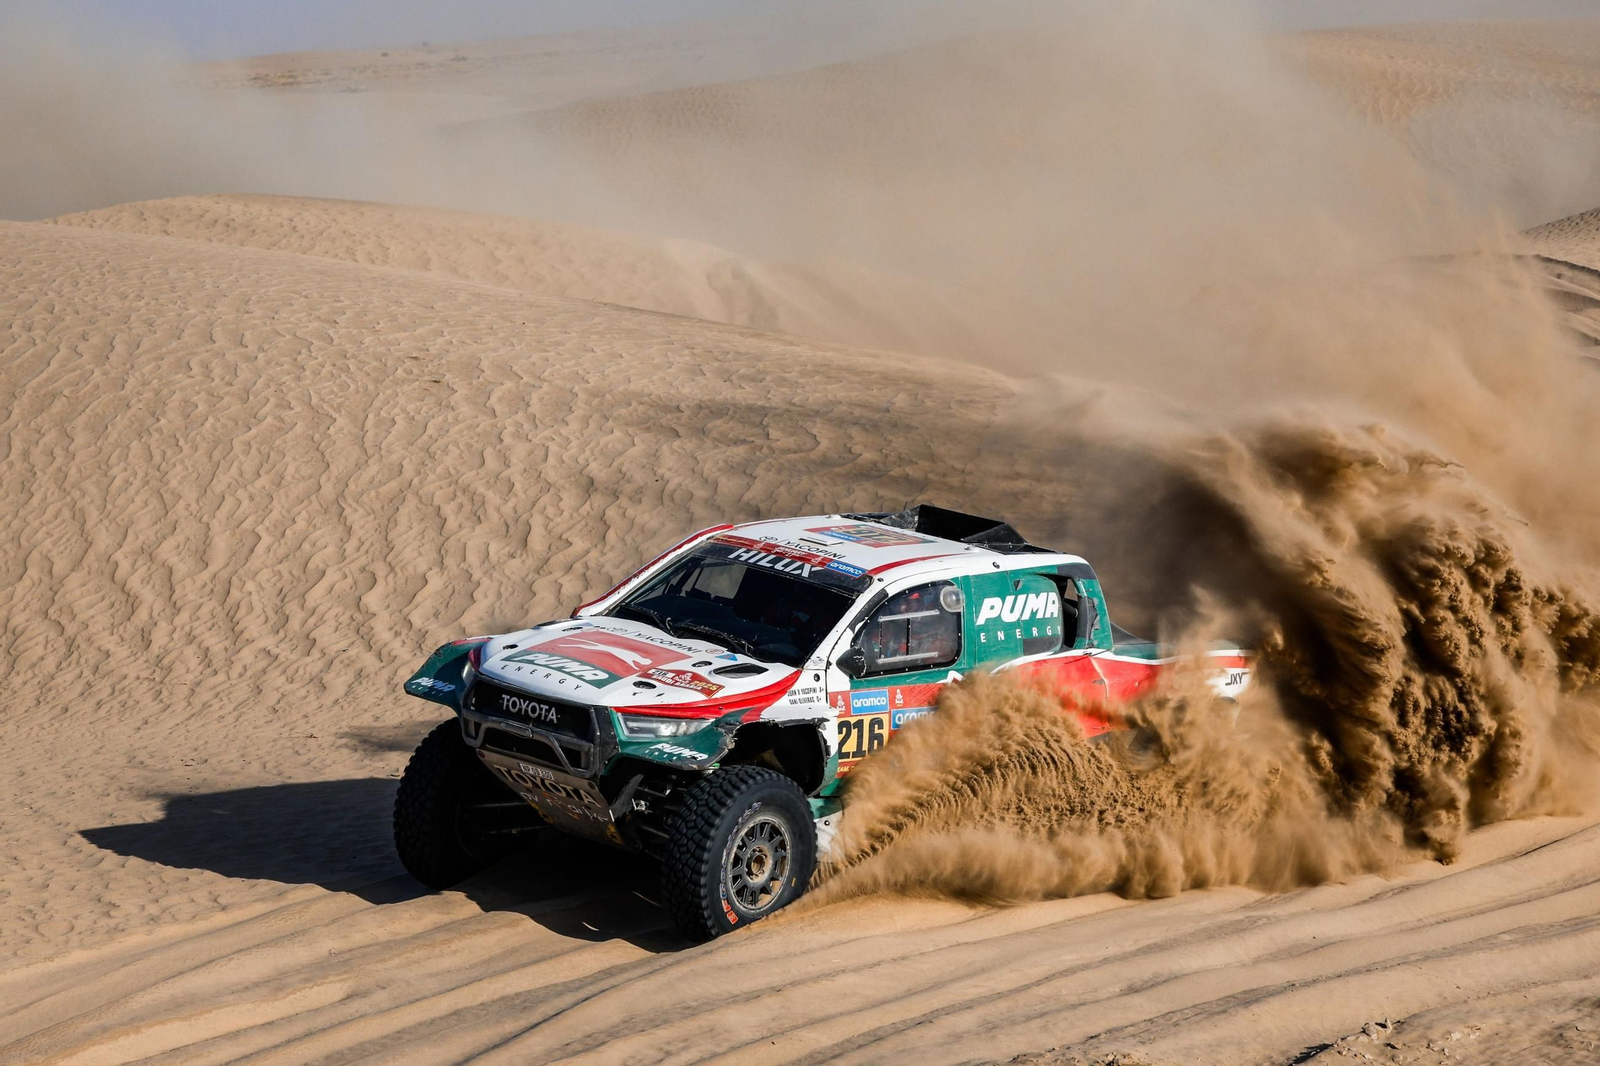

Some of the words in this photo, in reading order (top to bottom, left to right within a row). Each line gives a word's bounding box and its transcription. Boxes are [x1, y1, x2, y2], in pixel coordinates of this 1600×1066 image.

[786, 541, 846, 560] YACOPINI
[728, 548, 824, 578] HILUX
[830, 562, 863, 576] aramco
[976, 592, 1059, 626] PUMA
[634, 632, 702, 653] YACOPINI
[501, 664, 582, 691] ENERGY
[511, 653, 610, 681] PUMA
[411, 677, 456, 692] PUMA
[691, 680, 719, 691] 2025
[502, 694, 558, 724] TOYOTA
[853, 696, 887, 708] aramco
[837, 717, 884, 760] 216
[649, 742, 709, 761] PUMA
[493, 764, 602, 808] TOYOTA
